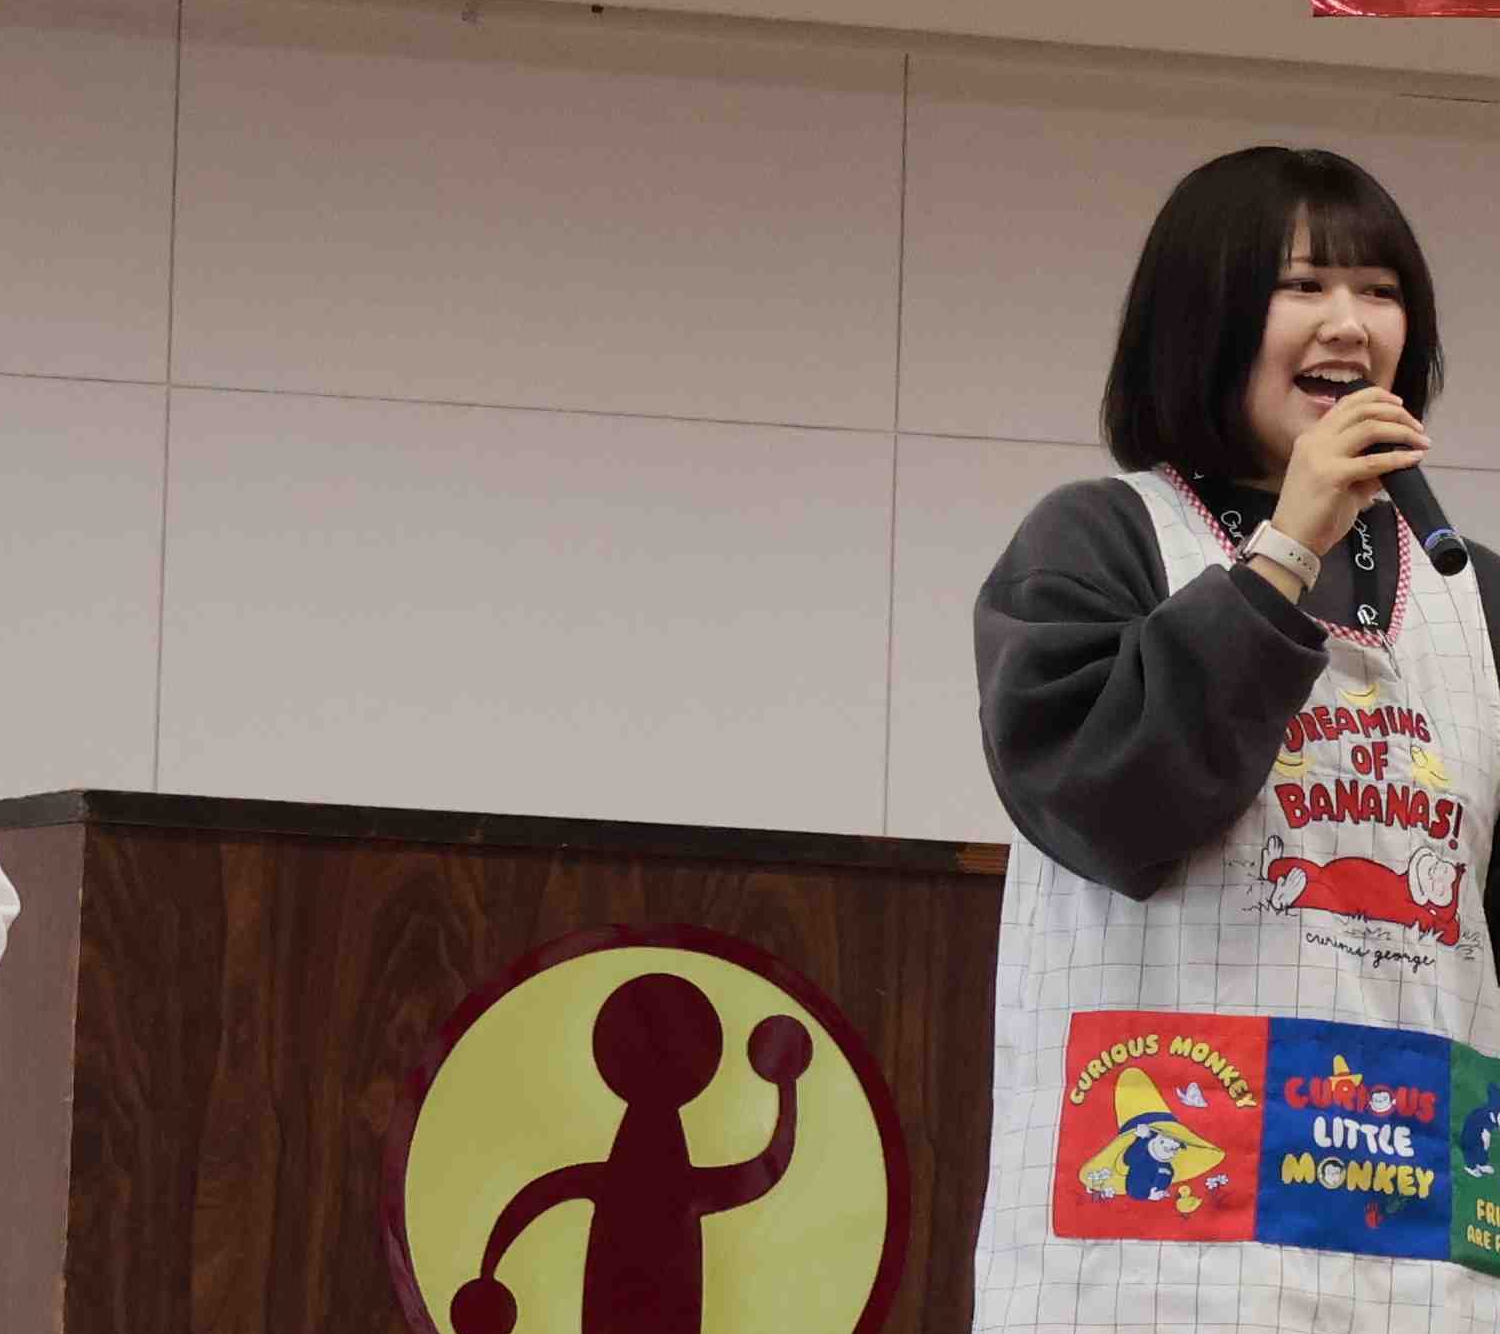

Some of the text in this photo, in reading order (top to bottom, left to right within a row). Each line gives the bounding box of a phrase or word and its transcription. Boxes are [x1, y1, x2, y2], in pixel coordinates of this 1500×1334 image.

[1283, 705, 1432, 753] DREAMING
[1351, 741, 1388, 780] OF
[1274, 779, 1463, 850] BANANAS!
[1374, 947, 1435, 972] george
[1070, 1033, 1258, 1109] CURIOUS MONKEY
[1284, 1074, 1437, 1124] CURIOUS
[1313, 1115, 1415, 1158] LITTLE
[1281, 1152, 1435, 1199] MONKEY
[1466, 1224, 1491, 1251] ARE
